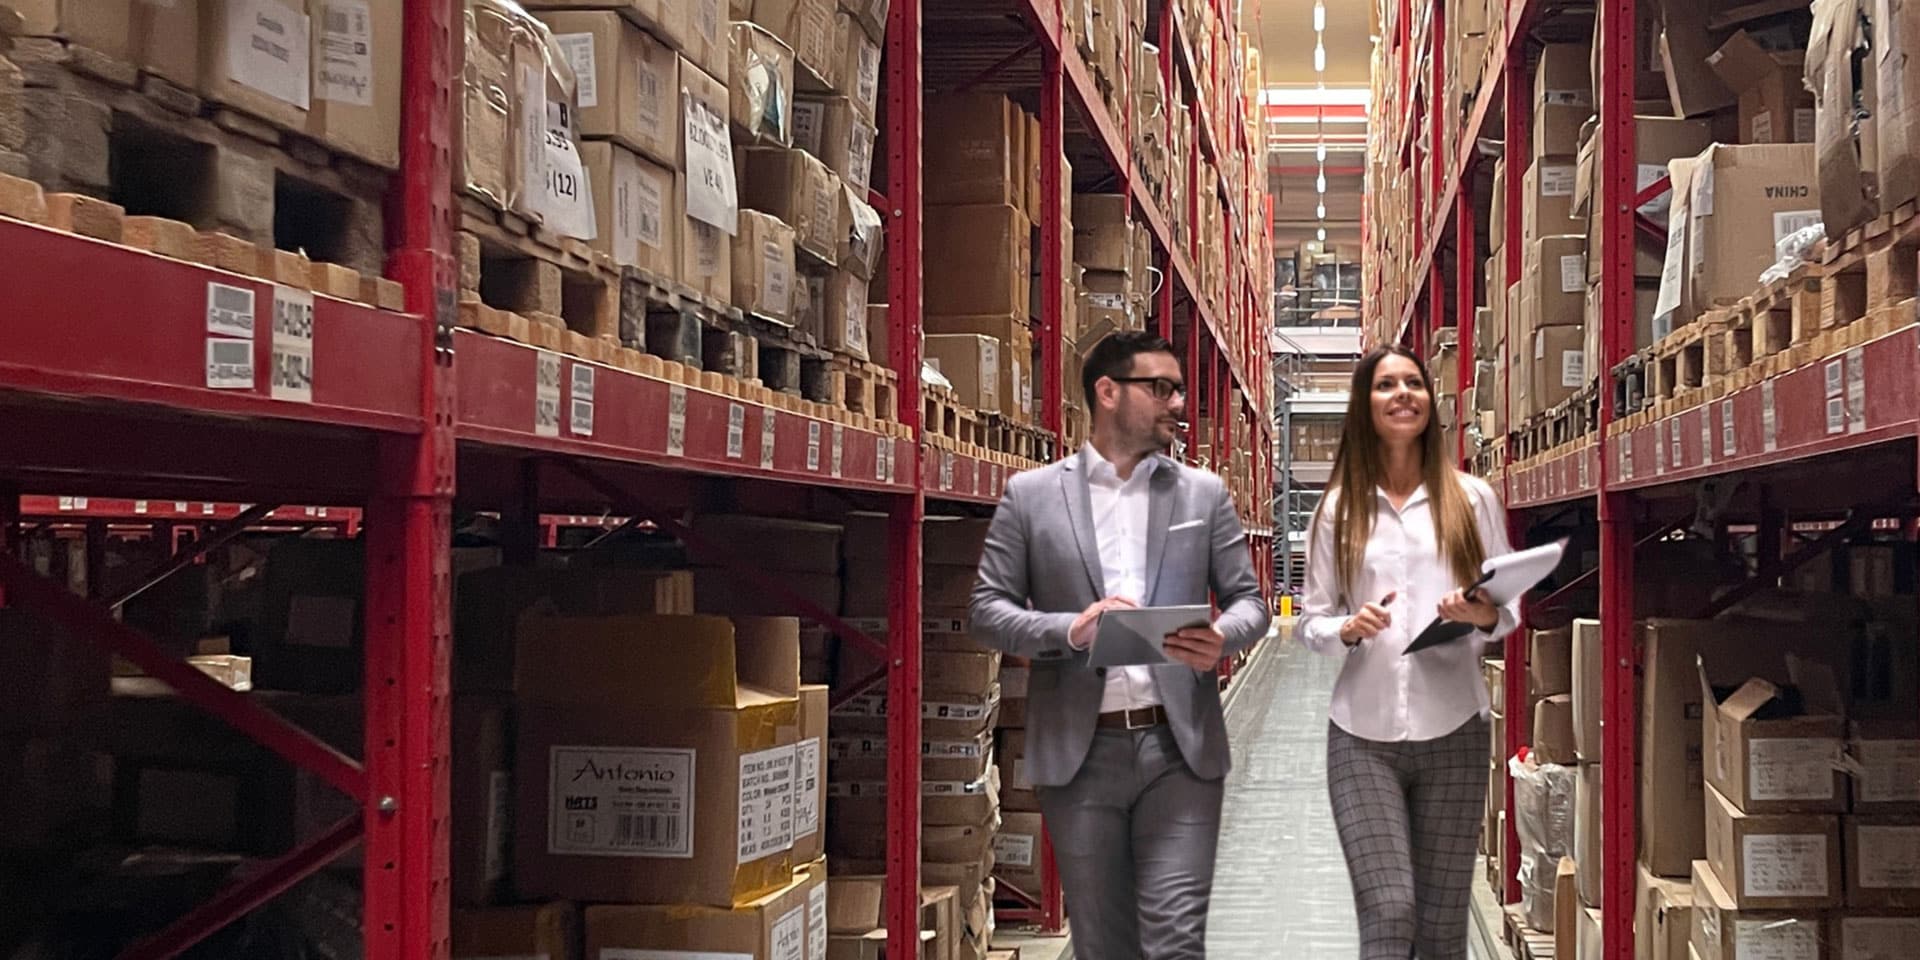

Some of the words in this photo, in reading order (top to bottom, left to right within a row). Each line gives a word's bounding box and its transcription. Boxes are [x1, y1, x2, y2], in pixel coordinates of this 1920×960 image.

[553, 169, 577, 203] (12)
[1765, 185, 1809, 199] CHINA
[572, 759, 676, 782] Antonio
